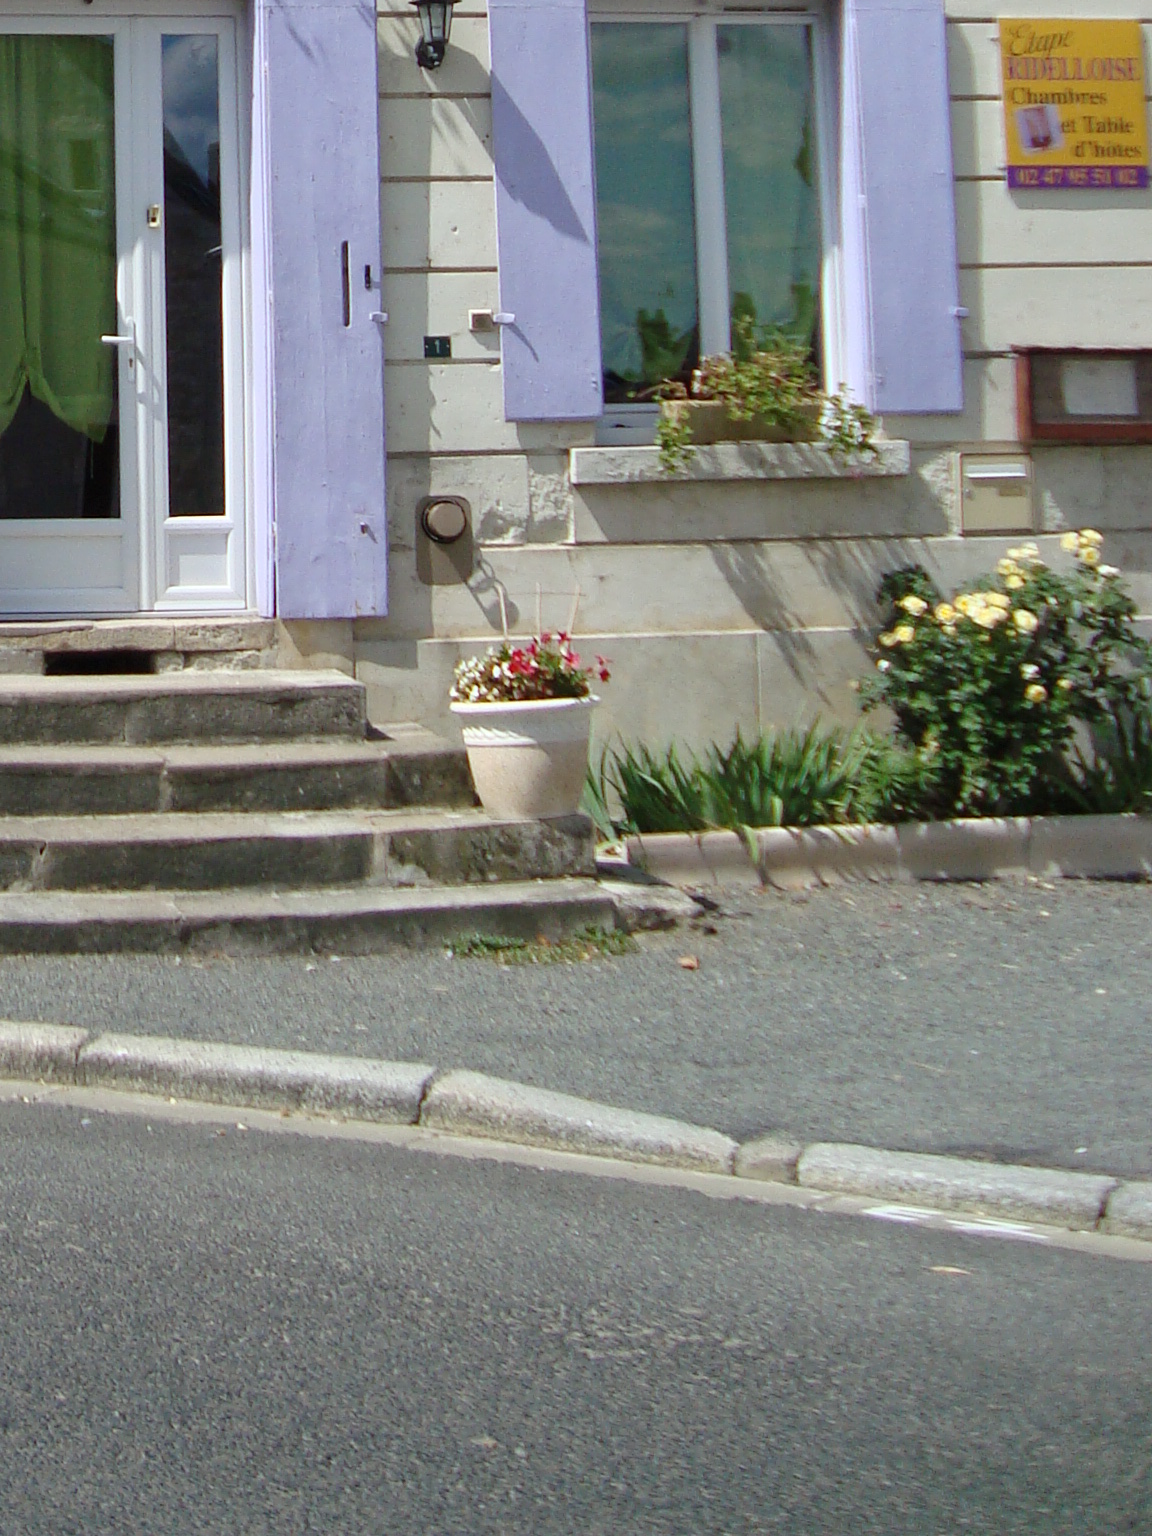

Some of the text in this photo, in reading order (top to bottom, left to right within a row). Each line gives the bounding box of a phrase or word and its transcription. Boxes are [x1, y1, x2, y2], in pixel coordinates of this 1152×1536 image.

[1011, 86, 1108, 105] Chambres
[1060, 115, 1135, 134] et Table
[433, 338, 441, 354] 1
